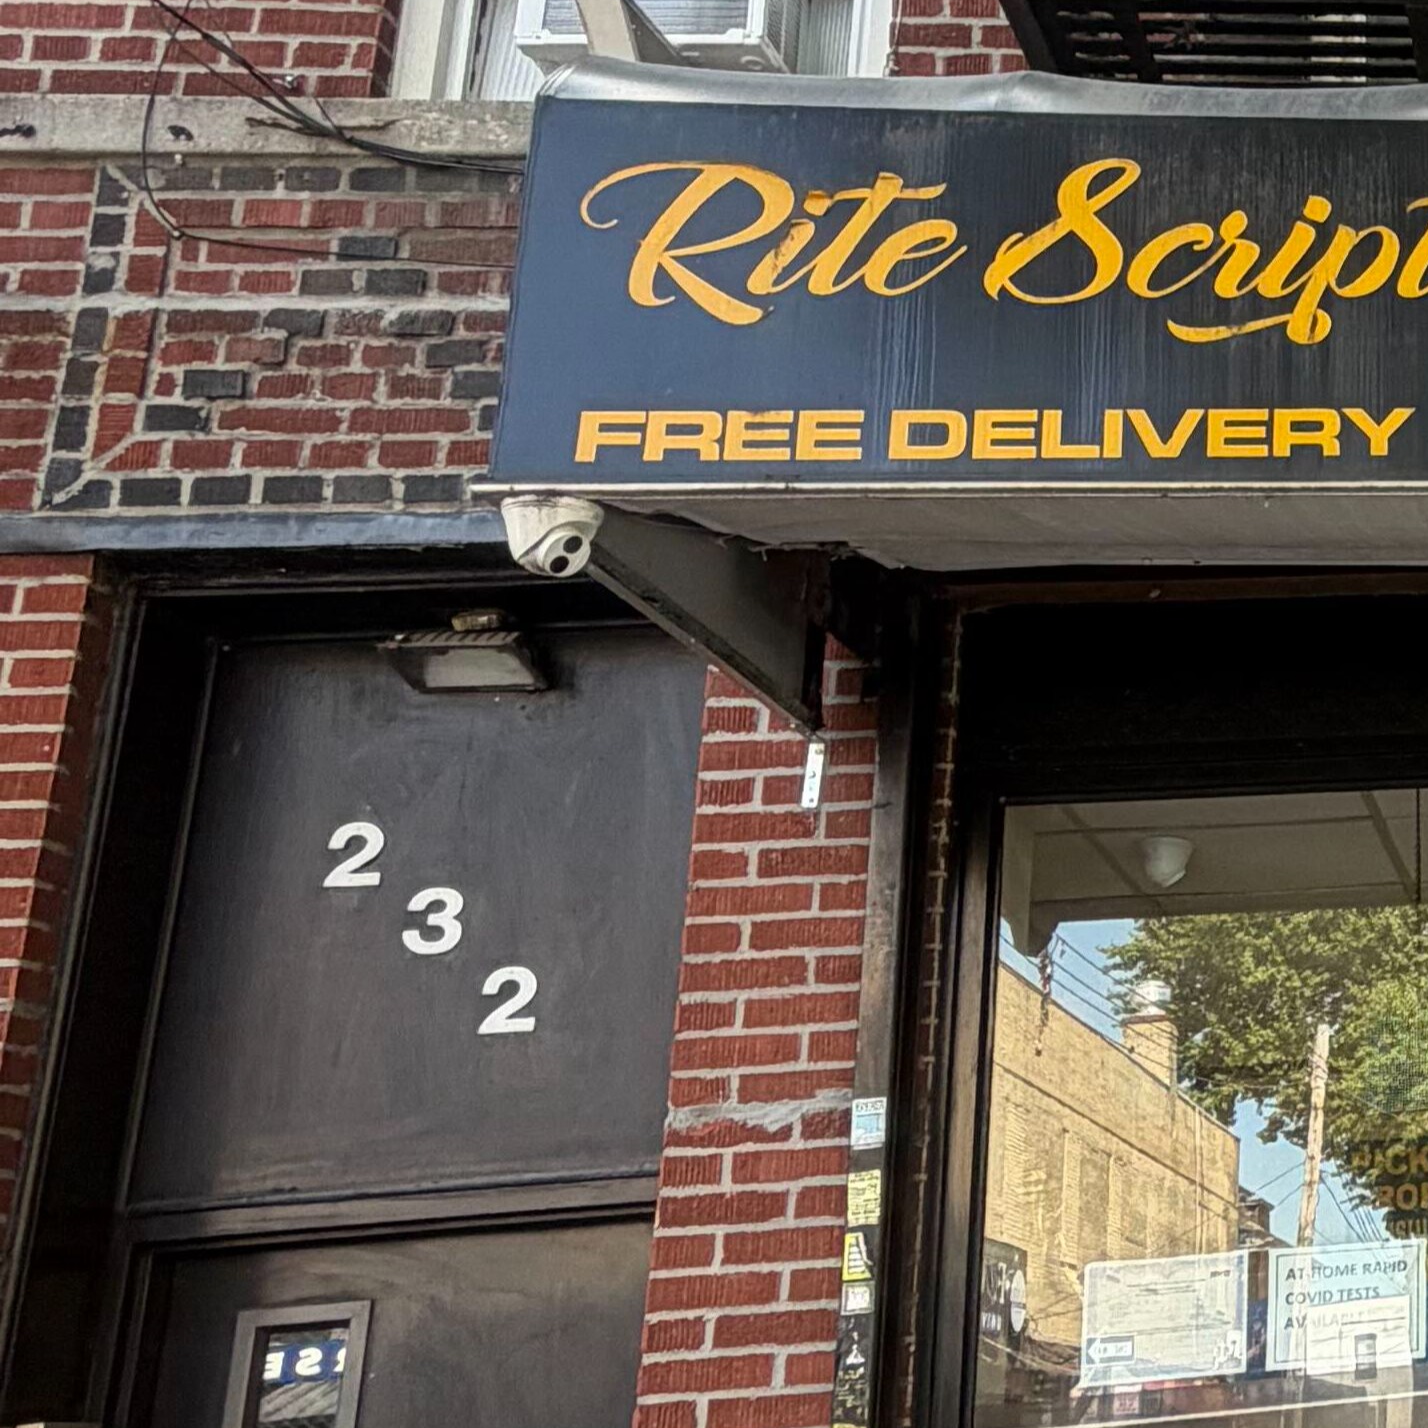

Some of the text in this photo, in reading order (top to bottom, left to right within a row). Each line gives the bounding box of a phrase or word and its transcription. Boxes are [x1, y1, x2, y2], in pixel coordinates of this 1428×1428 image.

[580, 160, 966, 326] Rite
[576, 408, 1416, 462] FREE DELIVERY
[1285, 1286, 1380, 1306] COVID TESTS
